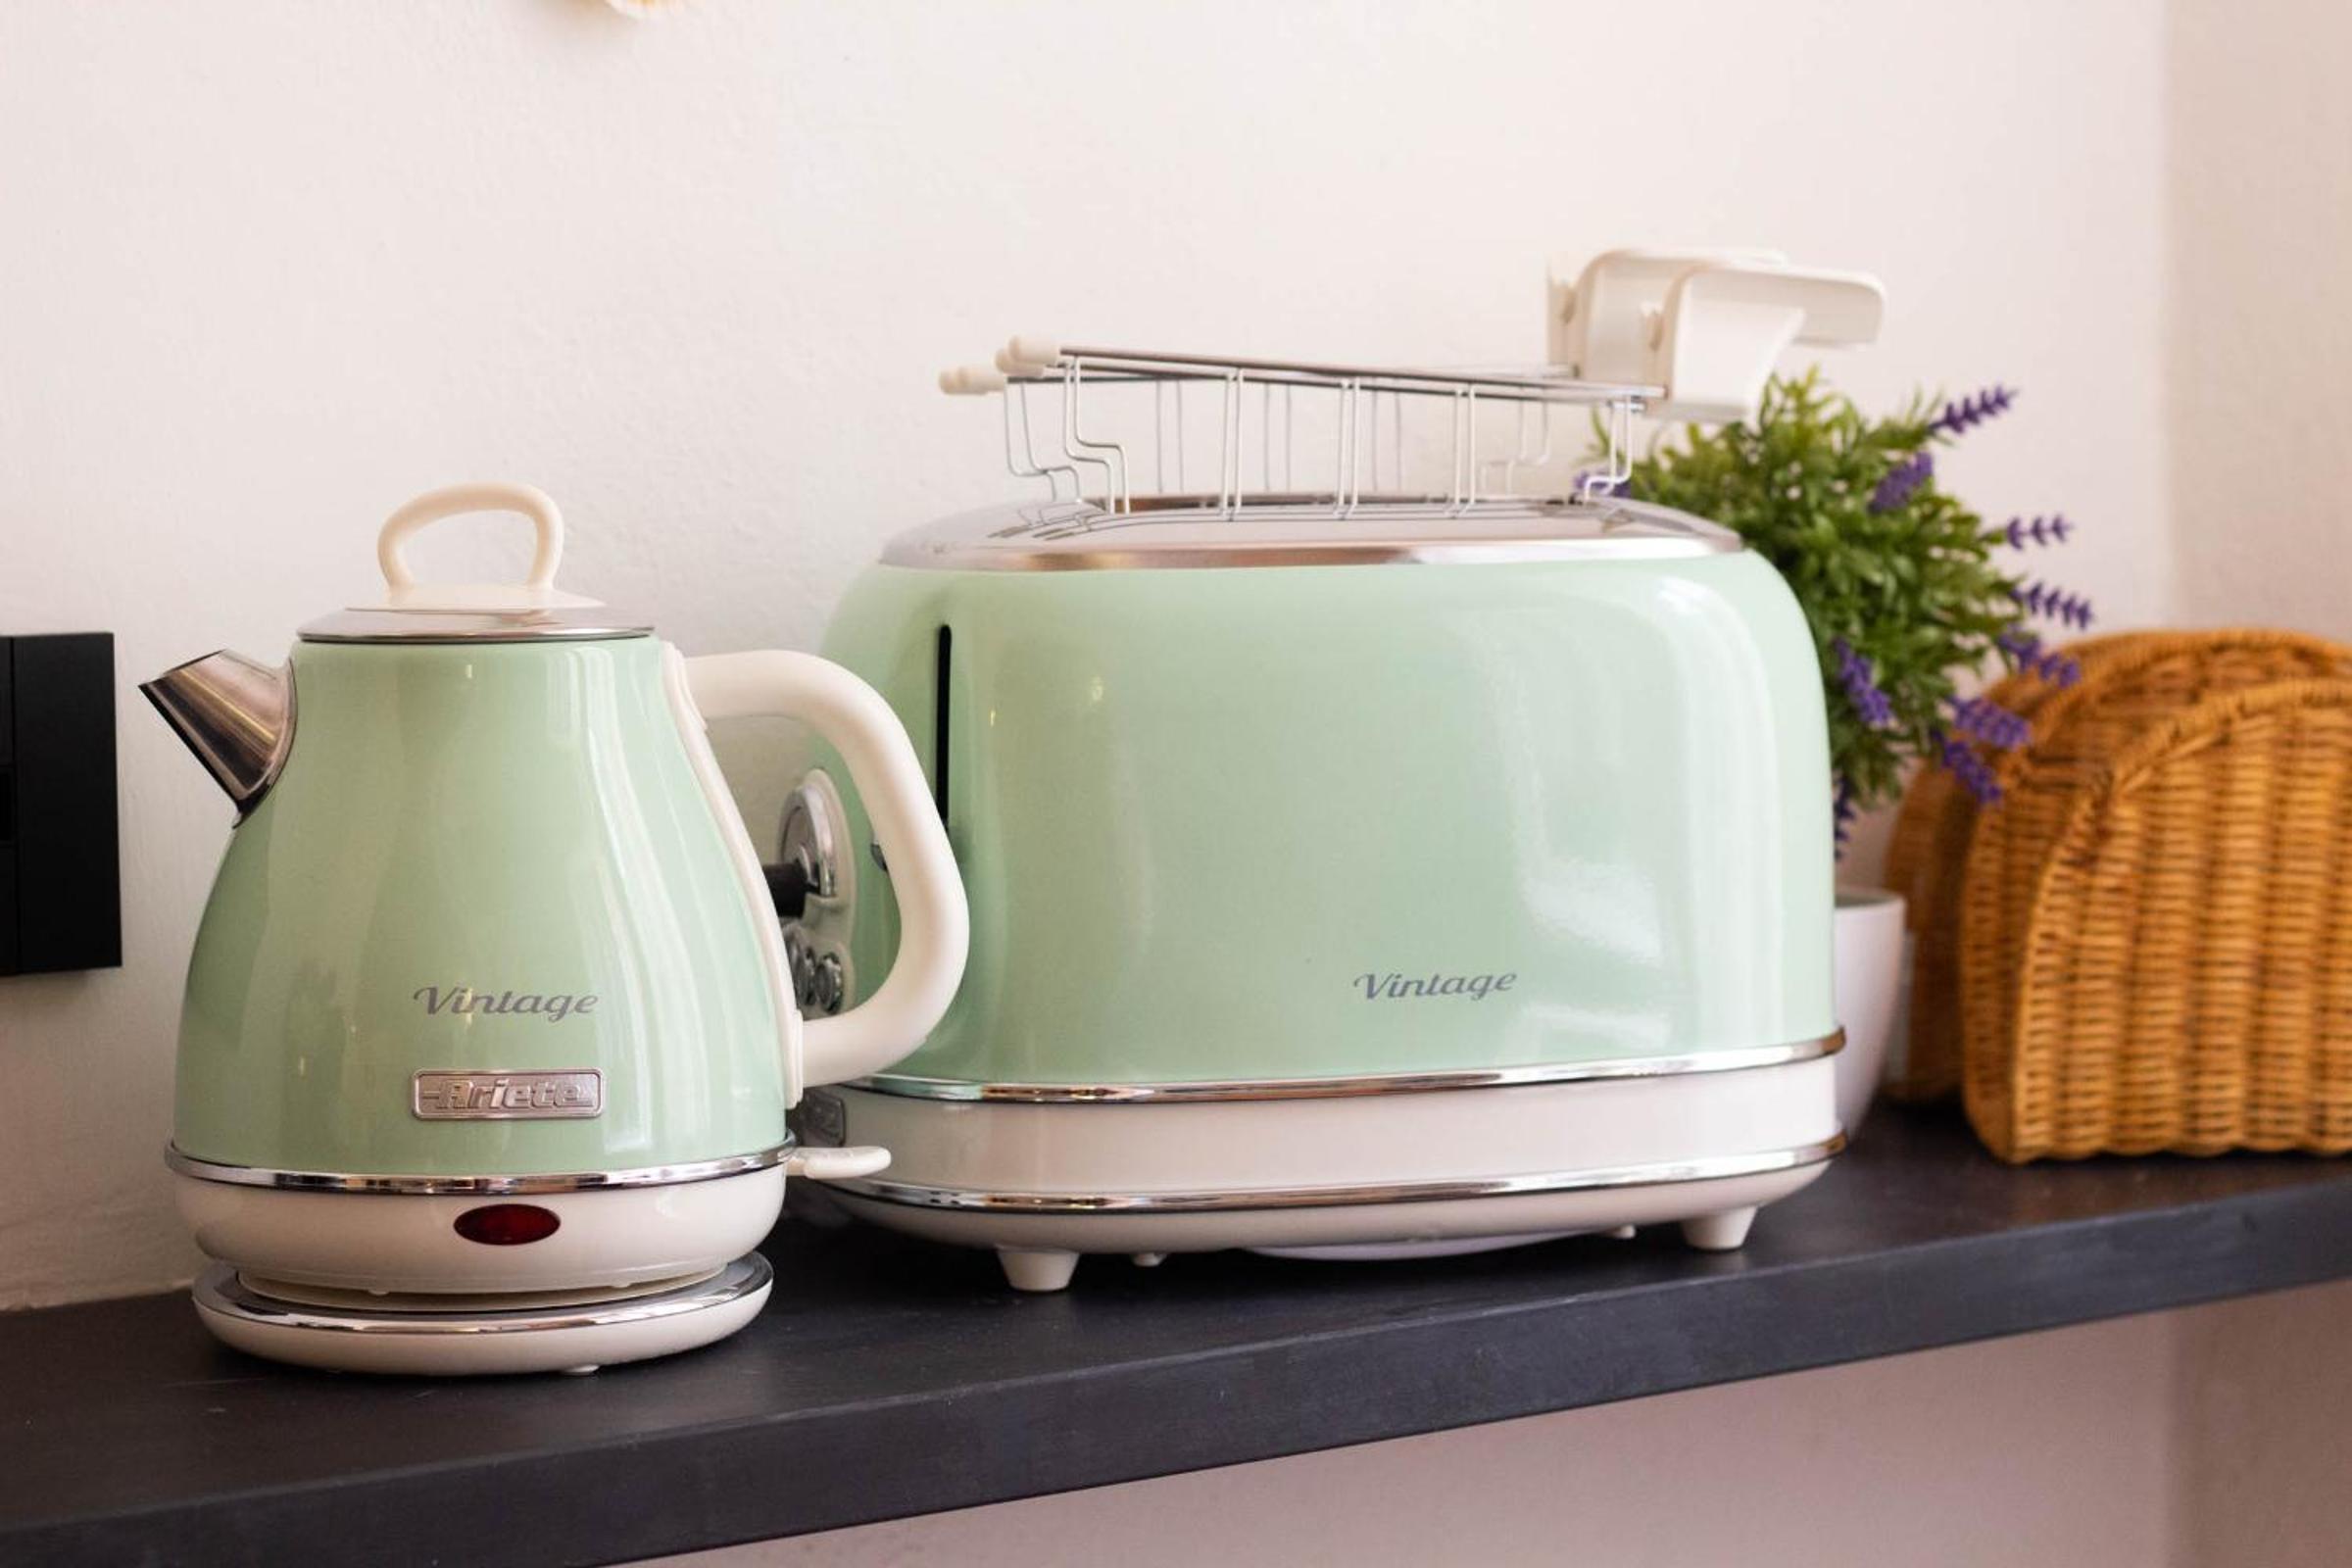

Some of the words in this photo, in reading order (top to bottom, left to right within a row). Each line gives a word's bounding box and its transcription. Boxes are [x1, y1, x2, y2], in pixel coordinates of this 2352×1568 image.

[1353, 972, 1517, 1002] Vintage
[414, 986, 598, 1022] Vintage
[437, 1078, 593, 1109] Ariete
